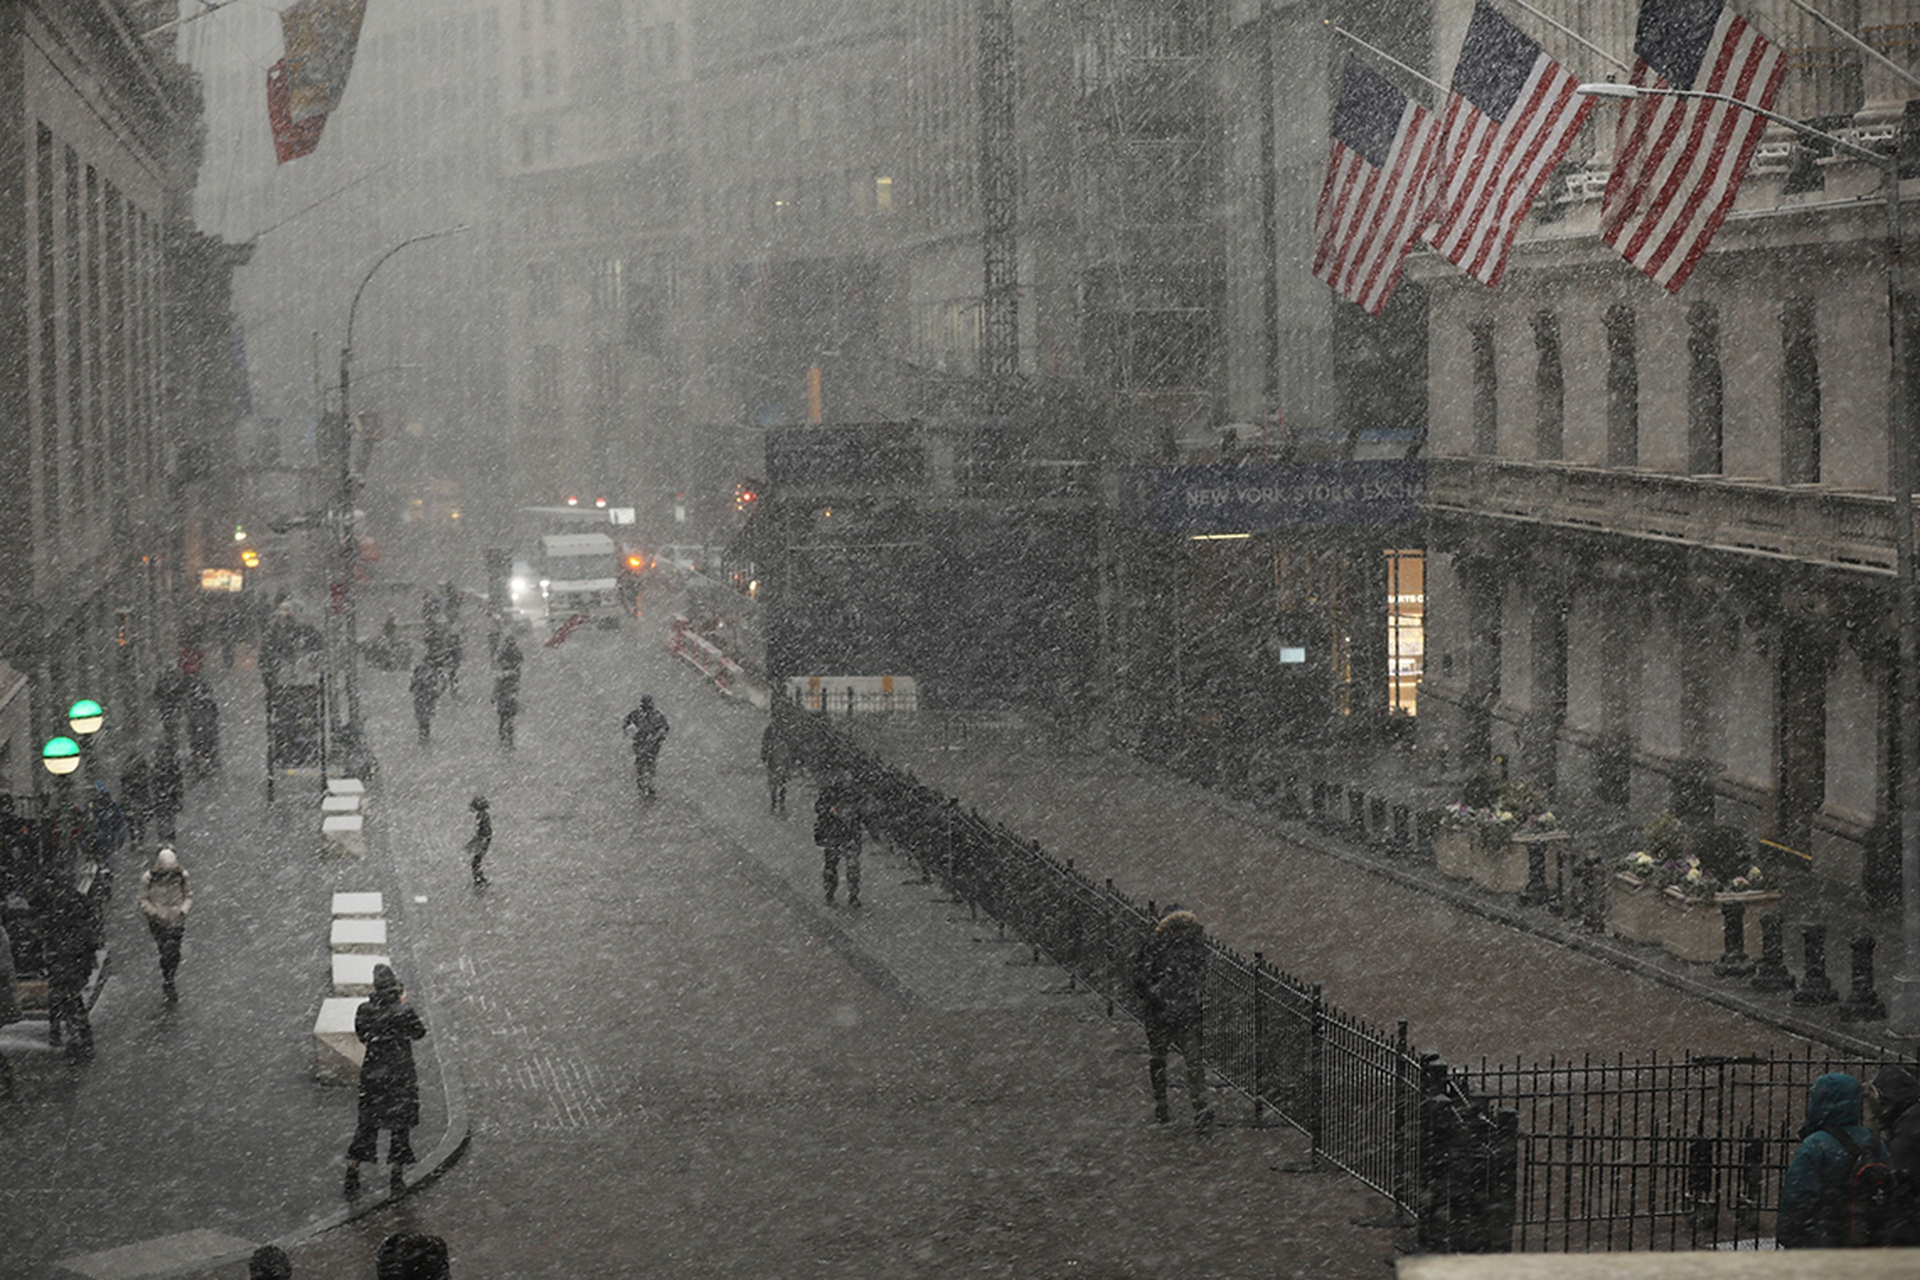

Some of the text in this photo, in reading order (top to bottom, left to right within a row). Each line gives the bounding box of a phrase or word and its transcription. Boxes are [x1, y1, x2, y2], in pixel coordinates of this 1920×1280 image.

[1186, 488, 1229, 505] NEW
[1237, 486, 1287, 503] YORK
[1293, 484, 1356, 502] STOCK
